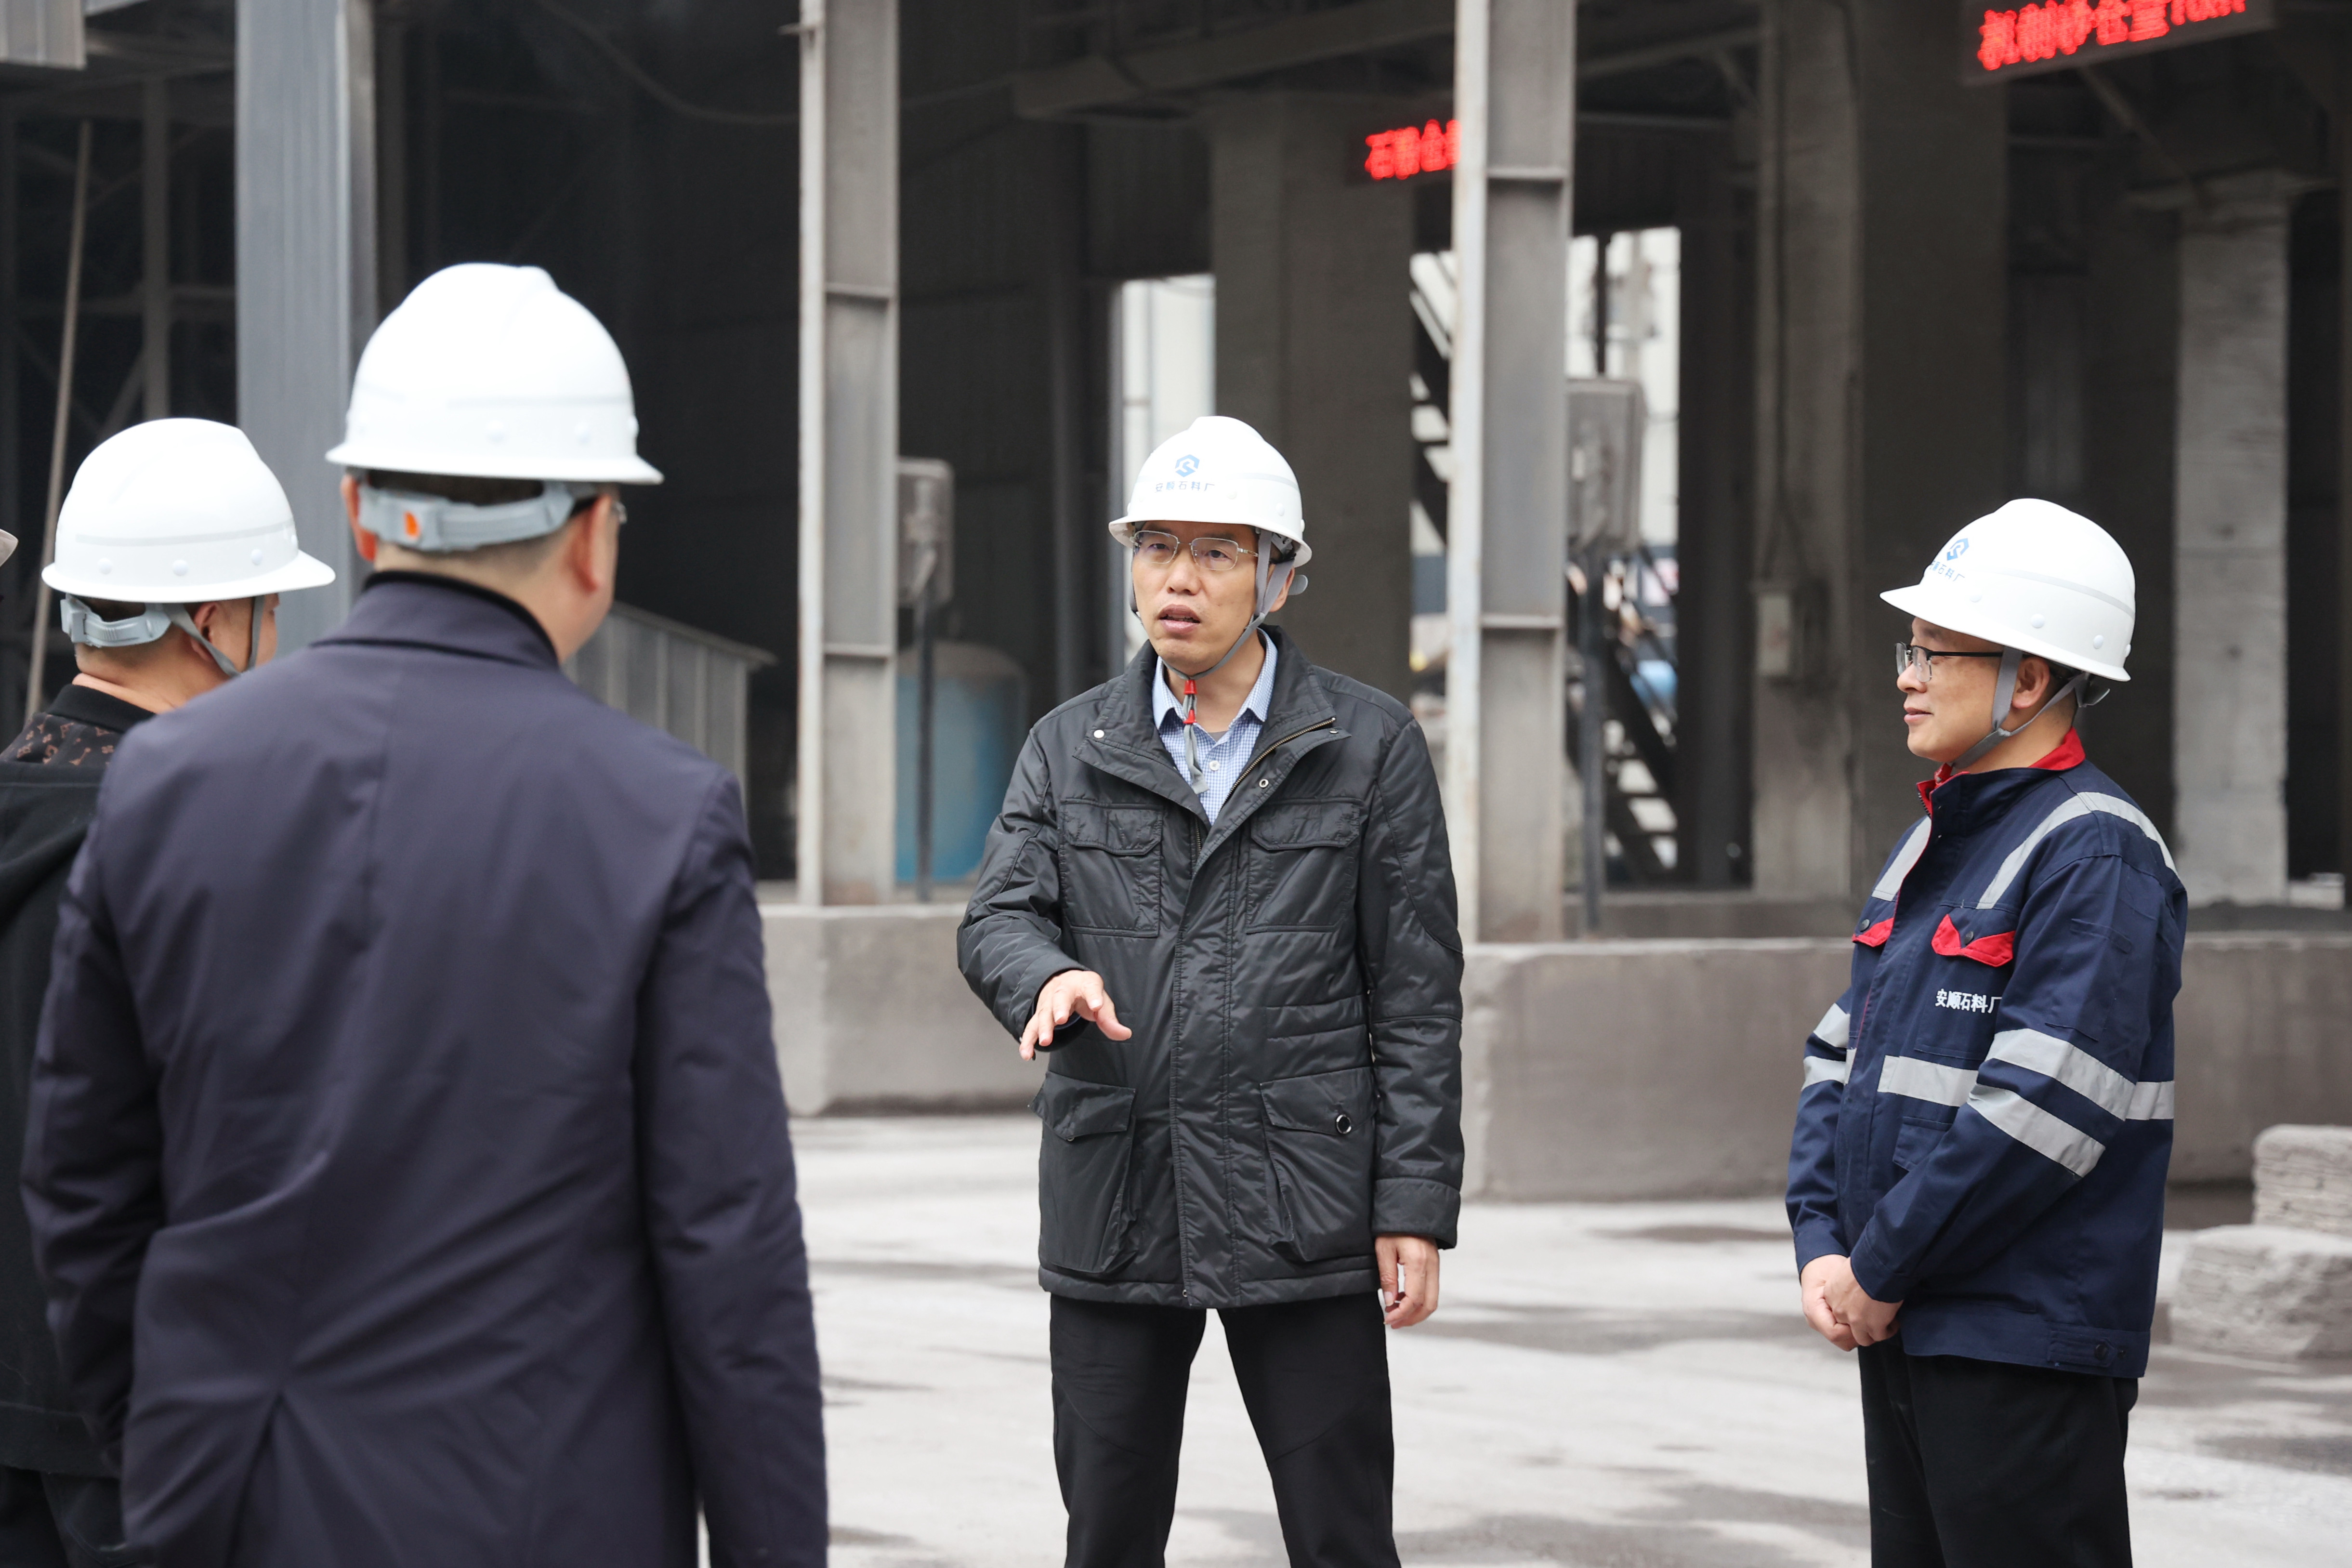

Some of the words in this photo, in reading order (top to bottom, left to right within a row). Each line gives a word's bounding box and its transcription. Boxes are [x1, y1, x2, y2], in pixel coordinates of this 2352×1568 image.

[1155, 481, 1215, 493] 安顺石料厂
[1935, 988, 2002, 1013] 安顺石料厂
